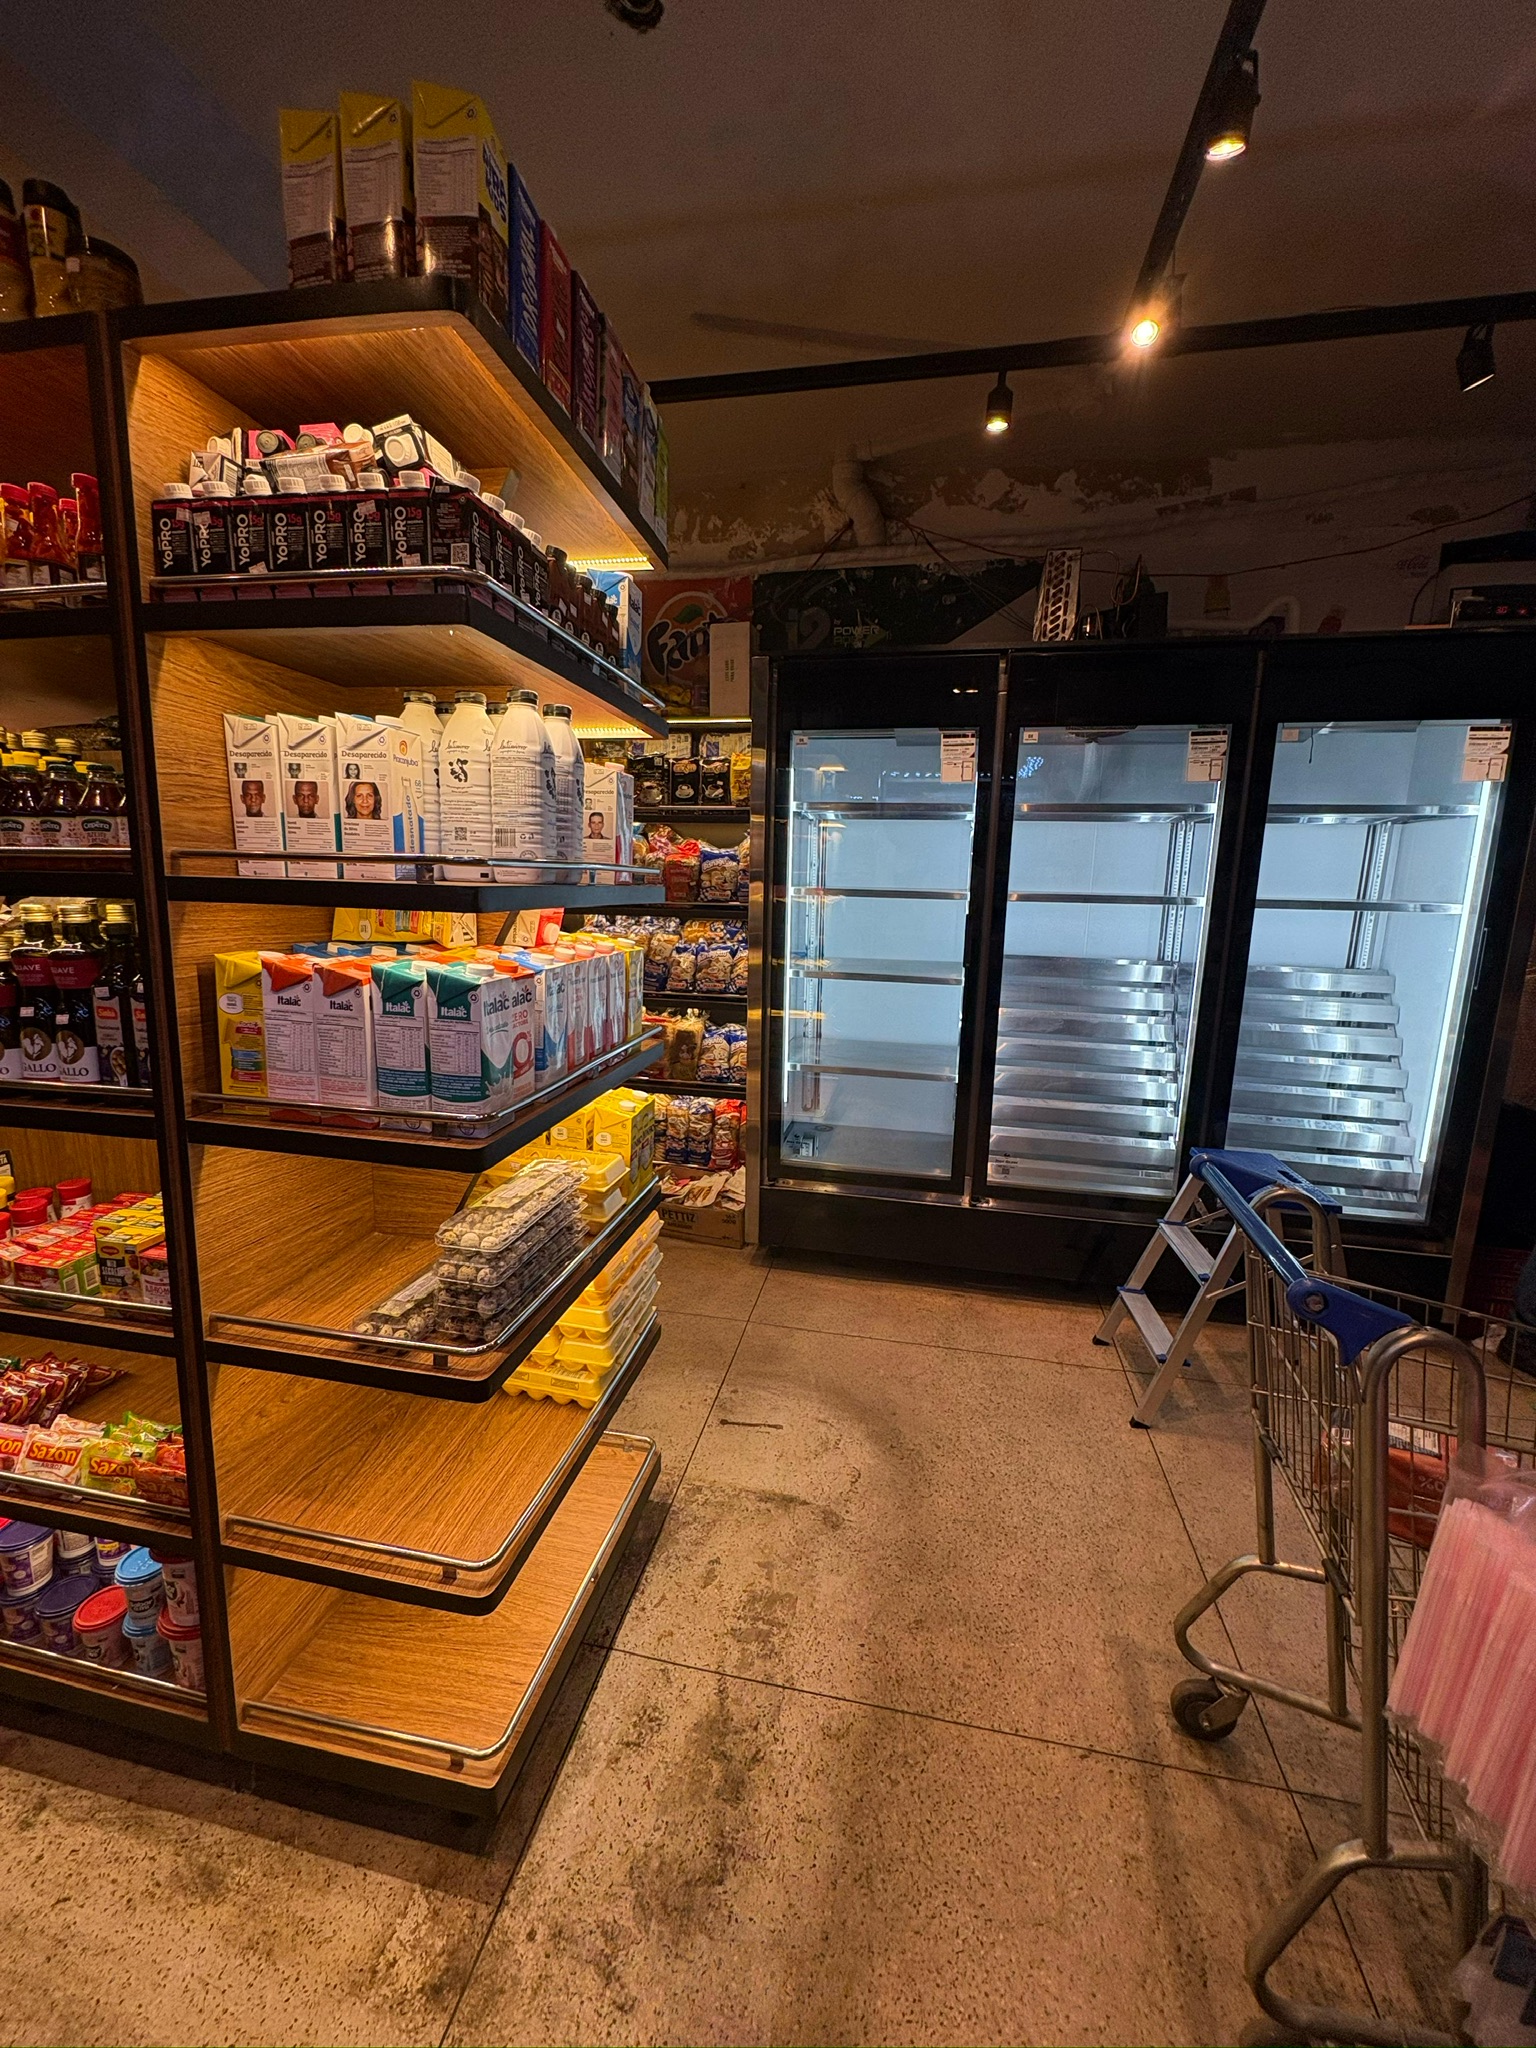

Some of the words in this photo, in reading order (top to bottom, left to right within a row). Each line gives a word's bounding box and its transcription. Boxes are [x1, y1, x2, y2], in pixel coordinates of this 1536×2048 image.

[407, 507, 422, 519] 15g
[236, 514, 250, 566] YoPRO
[274, 512, 288, 565] YoPRO
[313, 509, 328, 563] YoPRO
[159, 517, 174, 569] YoPRO
[646, 610, 722, 677] Fan
[229, 750, 273, 760] Desaparecido
[284, 750, 328, 760] Desaparecido
[341, 750, 387, 760] Desaparecido
[406, 794, 416, 853] desnatado
[277, 995, 301, 1007] Italac
[512, 989, 533, 1007] alac
[329, 1000, 354, 1011] Italac
[385, 1001, 411, 1013] Italac
[440, 1006, 468, 1018] Italac
[60, 1067, 89, 1077] ALLO
[661, 1209, 695, 1222] PETTIZ
[31, 1441, 77, 1464] Sazón
